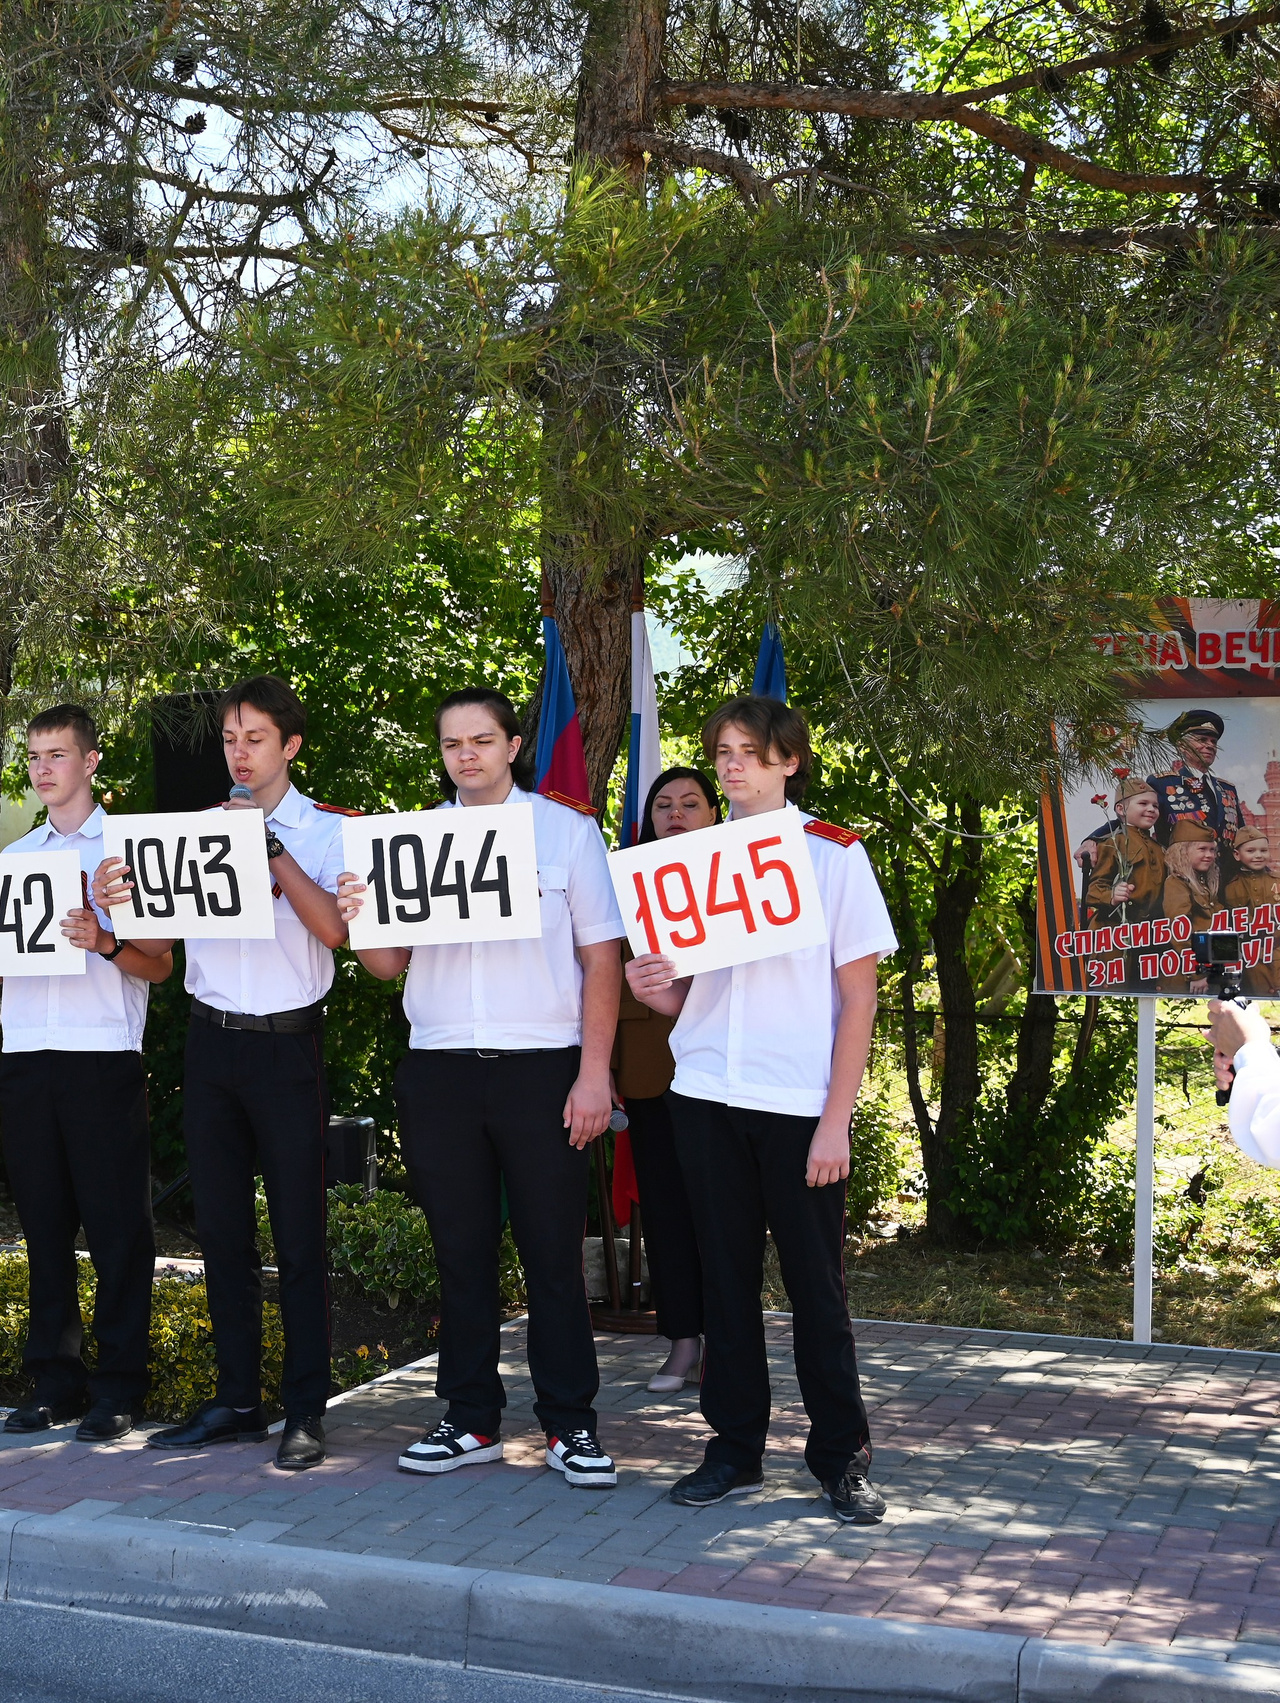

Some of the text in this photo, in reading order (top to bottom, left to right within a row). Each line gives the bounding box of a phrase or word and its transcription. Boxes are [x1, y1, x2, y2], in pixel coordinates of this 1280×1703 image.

[1090, 633, 1184, 666] ТЕНА
[122, 835, 242, 918] 1943
[367, 830, 513, 925] 1944
[632, 835, 801, 954] 1945
[1055, 914, 1192, 958] СПАСИБО
[1088, 936, 1274, 987] ЗА ПОБУ!
